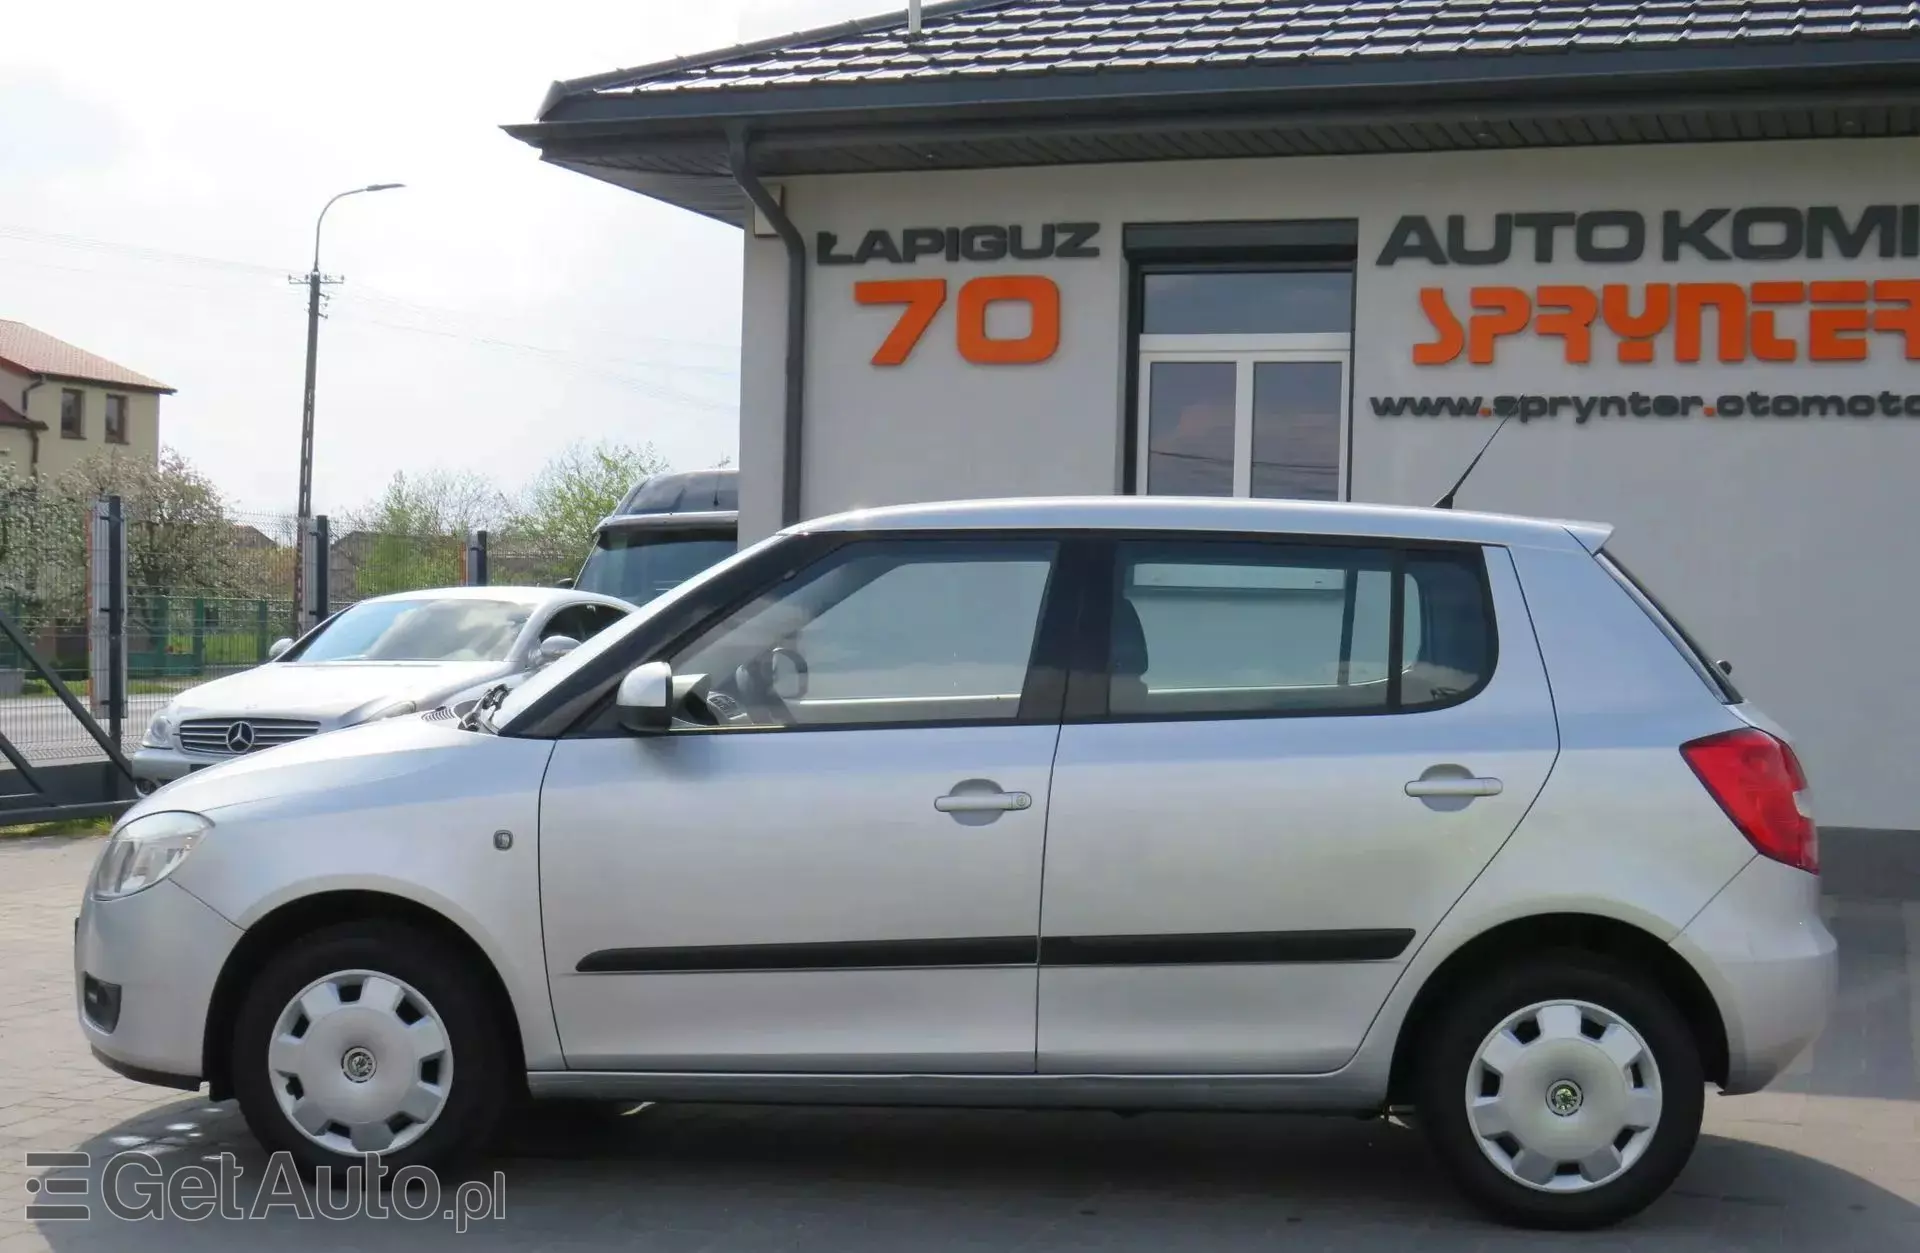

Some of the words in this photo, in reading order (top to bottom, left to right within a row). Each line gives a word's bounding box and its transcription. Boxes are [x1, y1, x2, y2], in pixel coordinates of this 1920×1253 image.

[816, 222, 1100, 266] ŁAPIGUZ
[1375, 209, 1647, 266] AUTO
[854, 274, 1061, 367] 70
[1412, 279, 1920, 365] SPRYNTER
